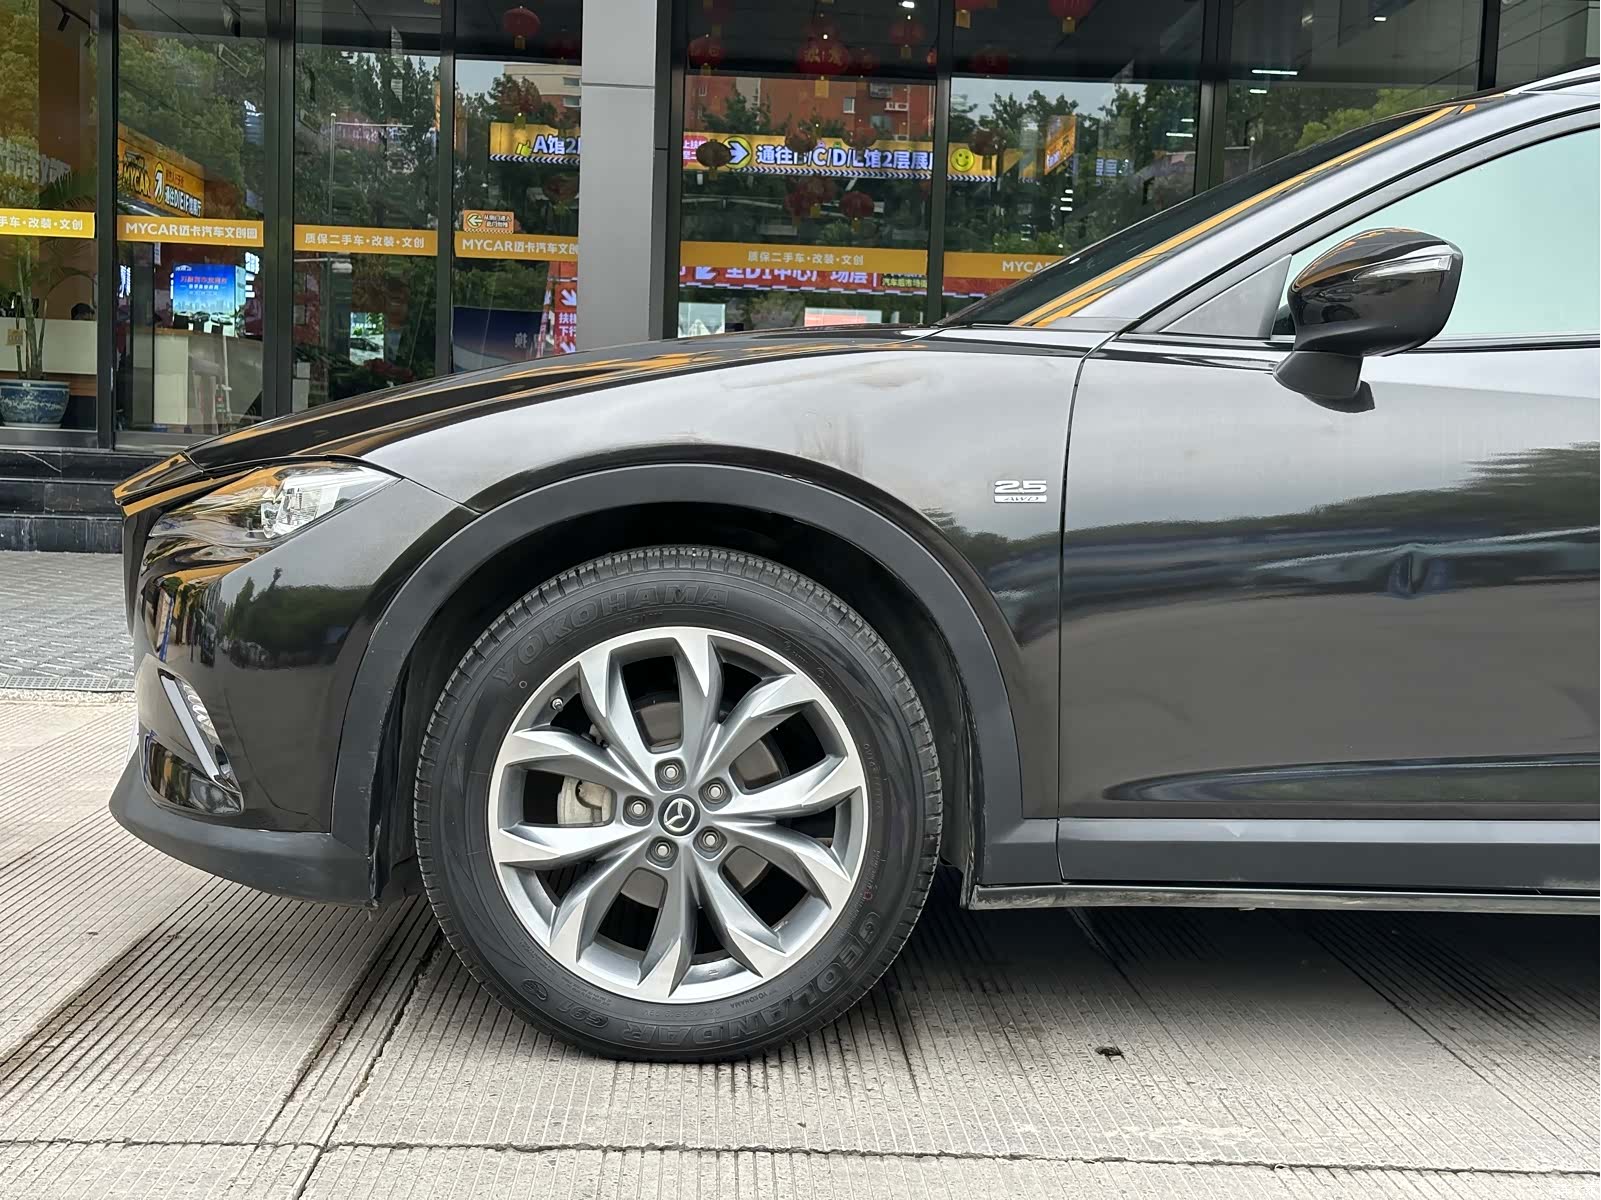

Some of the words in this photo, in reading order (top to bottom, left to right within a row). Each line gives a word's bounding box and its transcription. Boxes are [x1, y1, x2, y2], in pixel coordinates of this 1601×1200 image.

[533, 135, 580, 155] A馆2
[994, 480, 1047, 494] 2.5
[493, 584, 730, 688] YOKOHAMA
[623, 910, 882, 1046] GEOLANDAR
